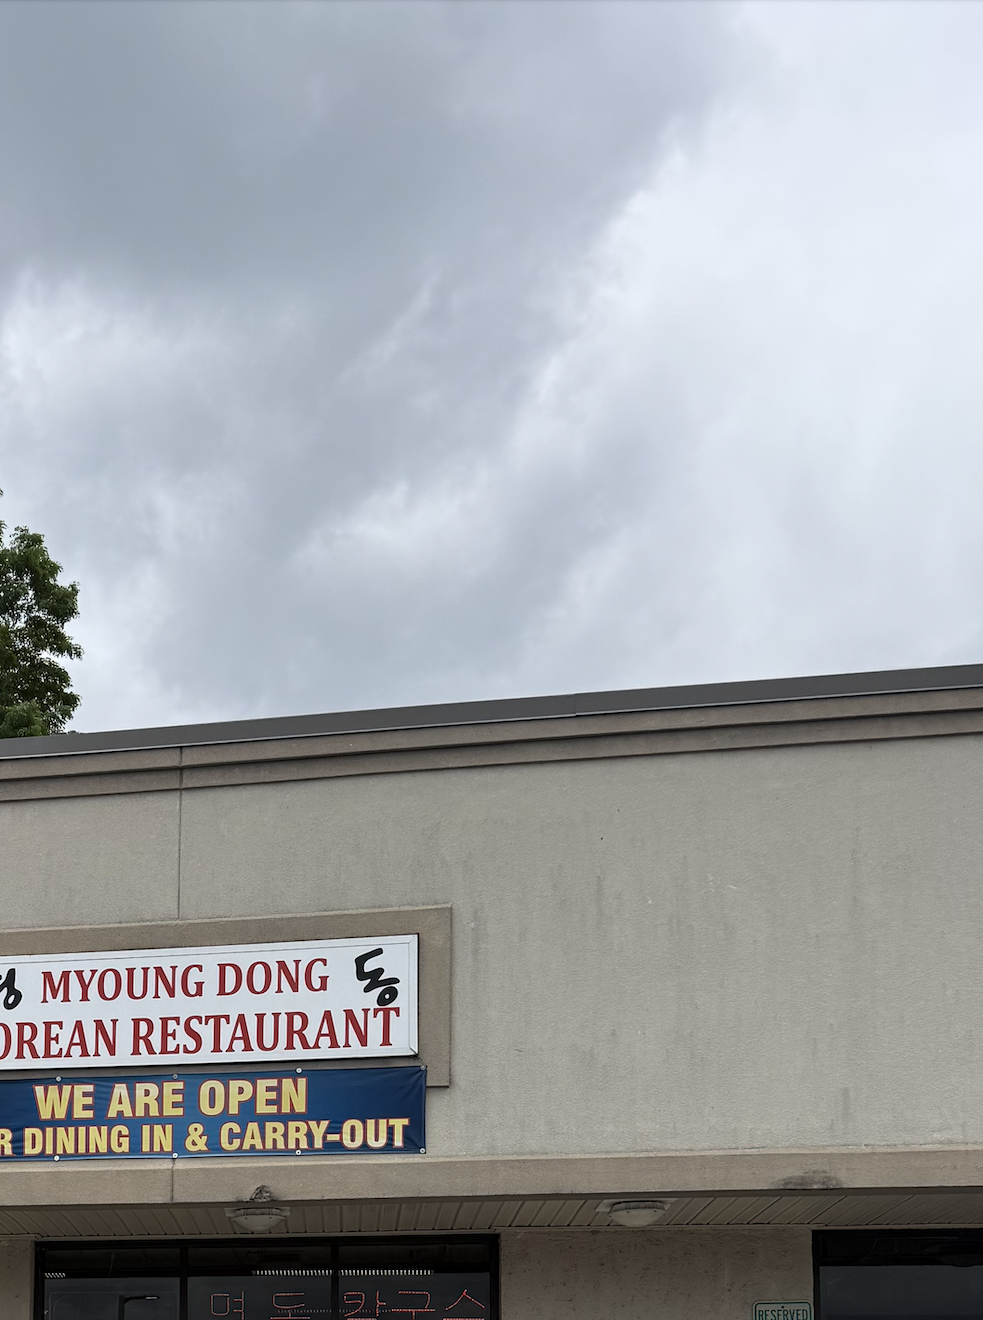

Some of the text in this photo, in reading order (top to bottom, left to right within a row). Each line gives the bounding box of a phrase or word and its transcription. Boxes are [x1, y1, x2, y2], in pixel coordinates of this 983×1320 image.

[41, 958, 329, 1003] MYOUNG DONG
[130, 1006, 401, 1057] RESTAURANT
[34, 1077, 308, 1122] WE ARE OPEN
[24, 1126, 130, 1155] DINING
[140, 1125, 174, 1153] IN
[184, 1124, 210, 1152] &
[219, 1117, 410, 1151] CARRY-OUT
